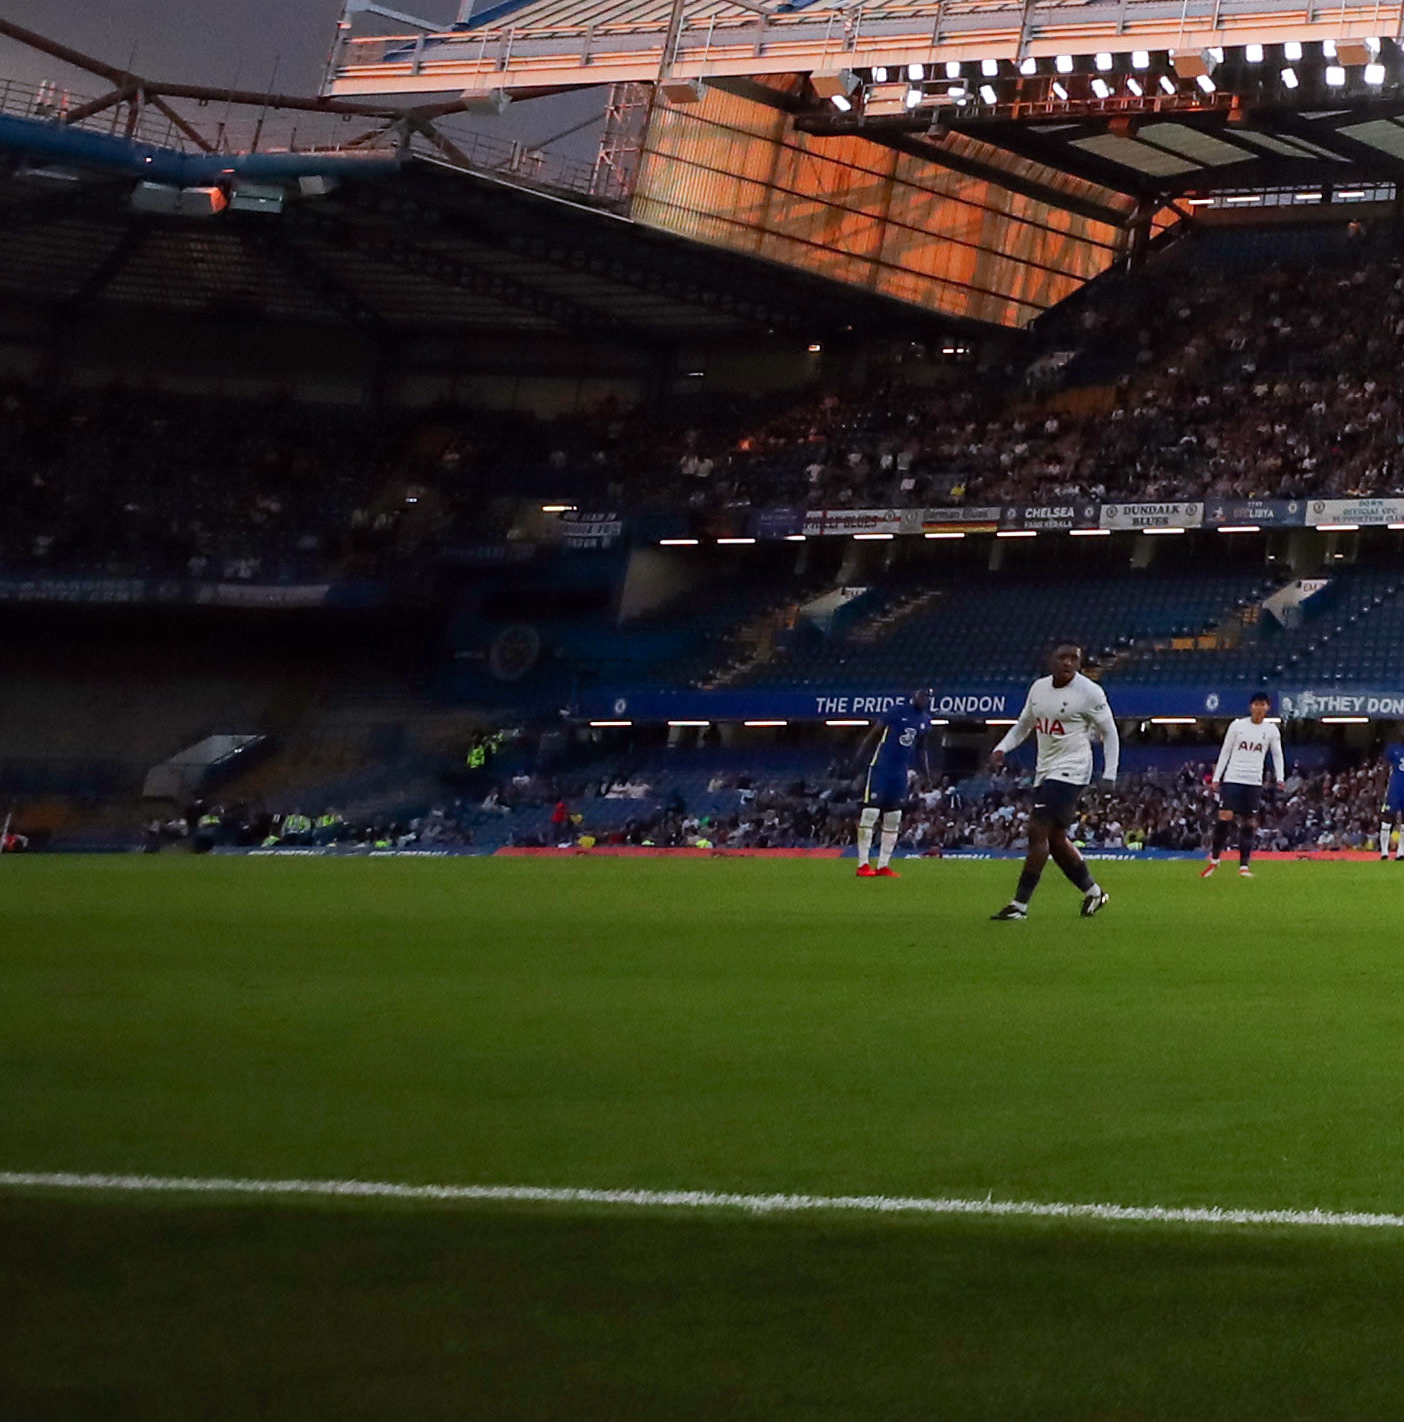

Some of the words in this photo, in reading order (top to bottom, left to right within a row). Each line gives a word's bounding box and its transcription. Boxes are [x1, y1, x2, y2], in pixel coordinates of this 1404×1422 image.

[1025, 506, 1075, 519] CHELSEA
[1123, 504, 1181, 516] DUNDALK
[1132, 515, 1170, 526] BLUES
[815, 697, 849, 713] THE
[929, 696, 1006, 712] LONDON
[1316, 696, 1366, 712] THEY
[1036, 718, 1065, 735] AIA
[1238, 741, 1263, 752] AIA
